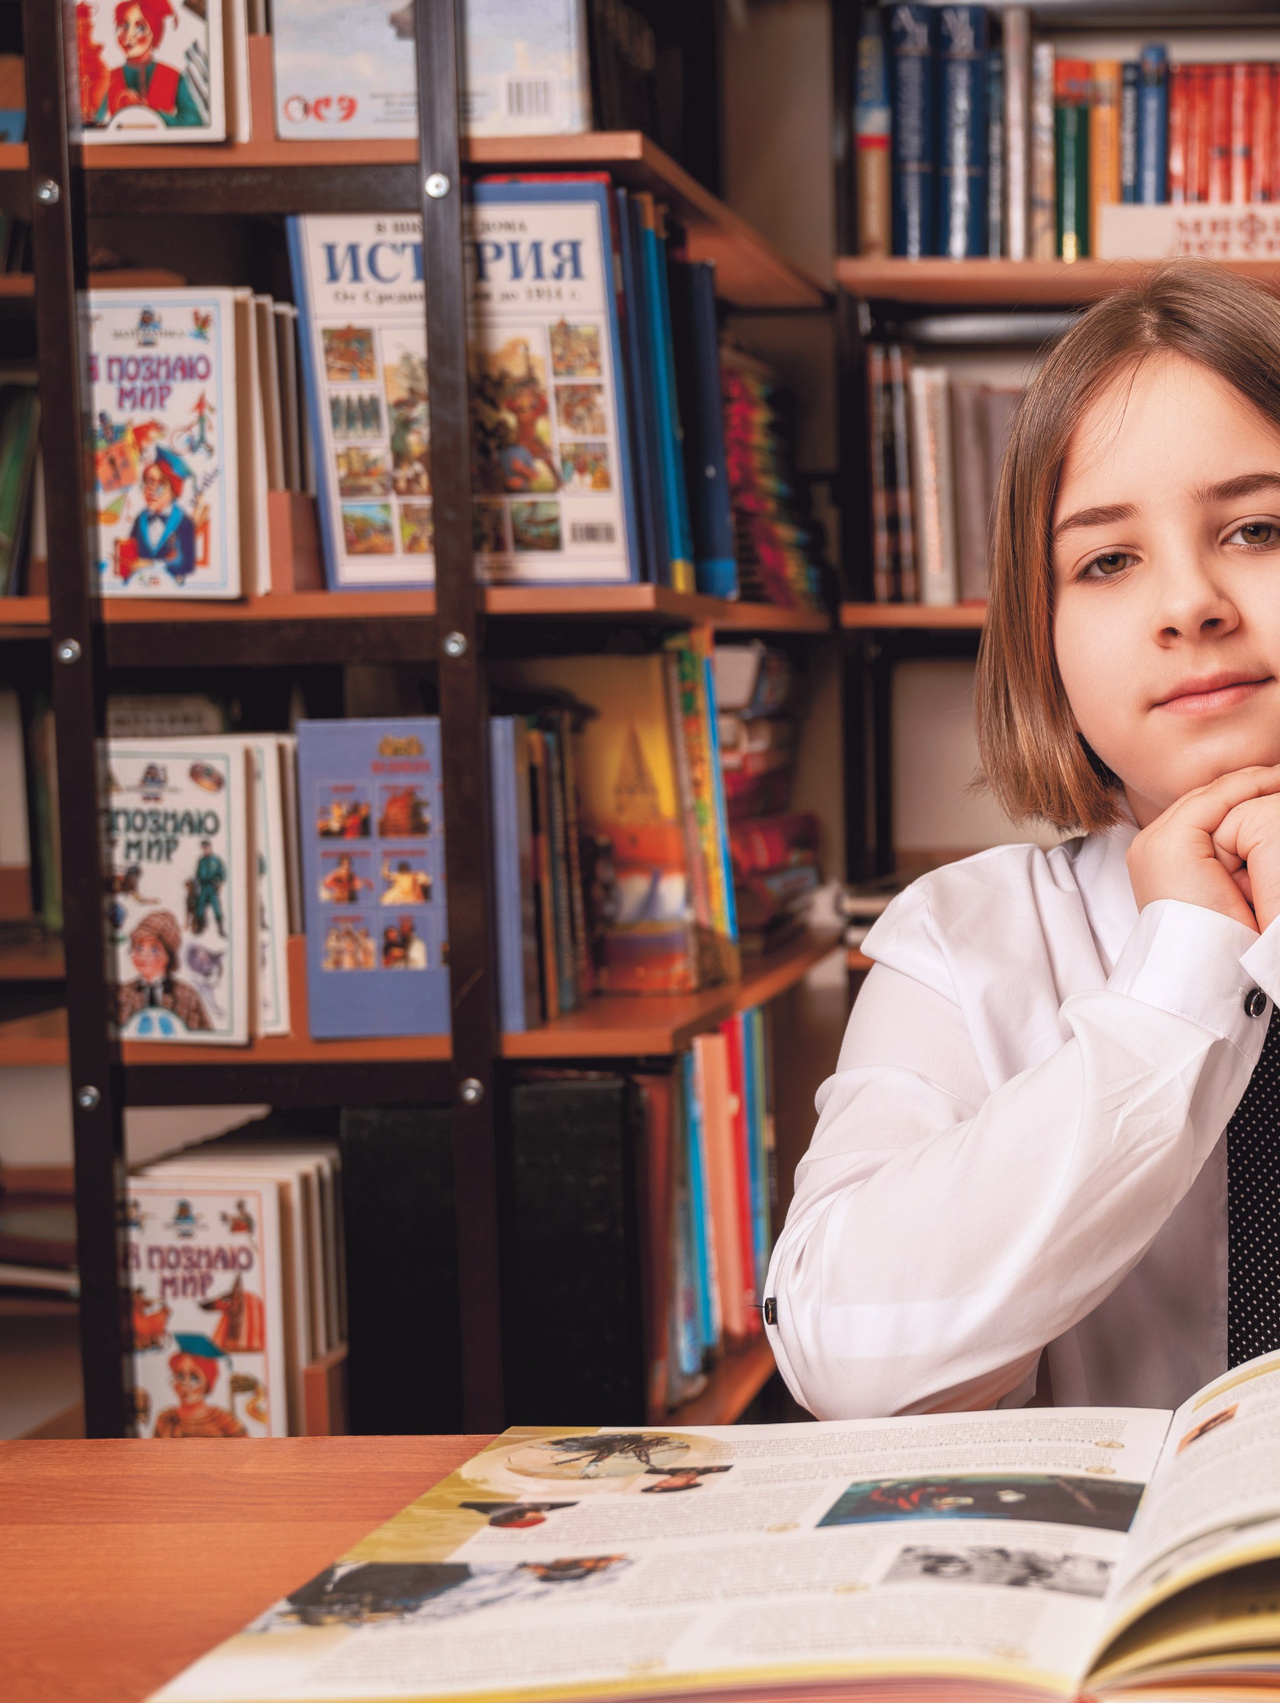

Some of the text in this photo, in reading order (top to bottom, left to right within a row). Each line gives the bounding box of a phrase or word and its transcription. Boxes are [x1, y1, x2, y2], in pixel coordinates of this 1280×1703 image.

[322, 239, 585, 284] ИСТРИЯ
[106, 354, 212, 383] ПОЗНАЮ
[117, 384, 173, 411] МИР
[110, 808, 220, 837] ПОЗНАЮ
[124, 838, 179, 864] МИР
[147, 1244, 254, 1273] ПОЗНАЮ
[160, 1274, 214, 1298] МИР
